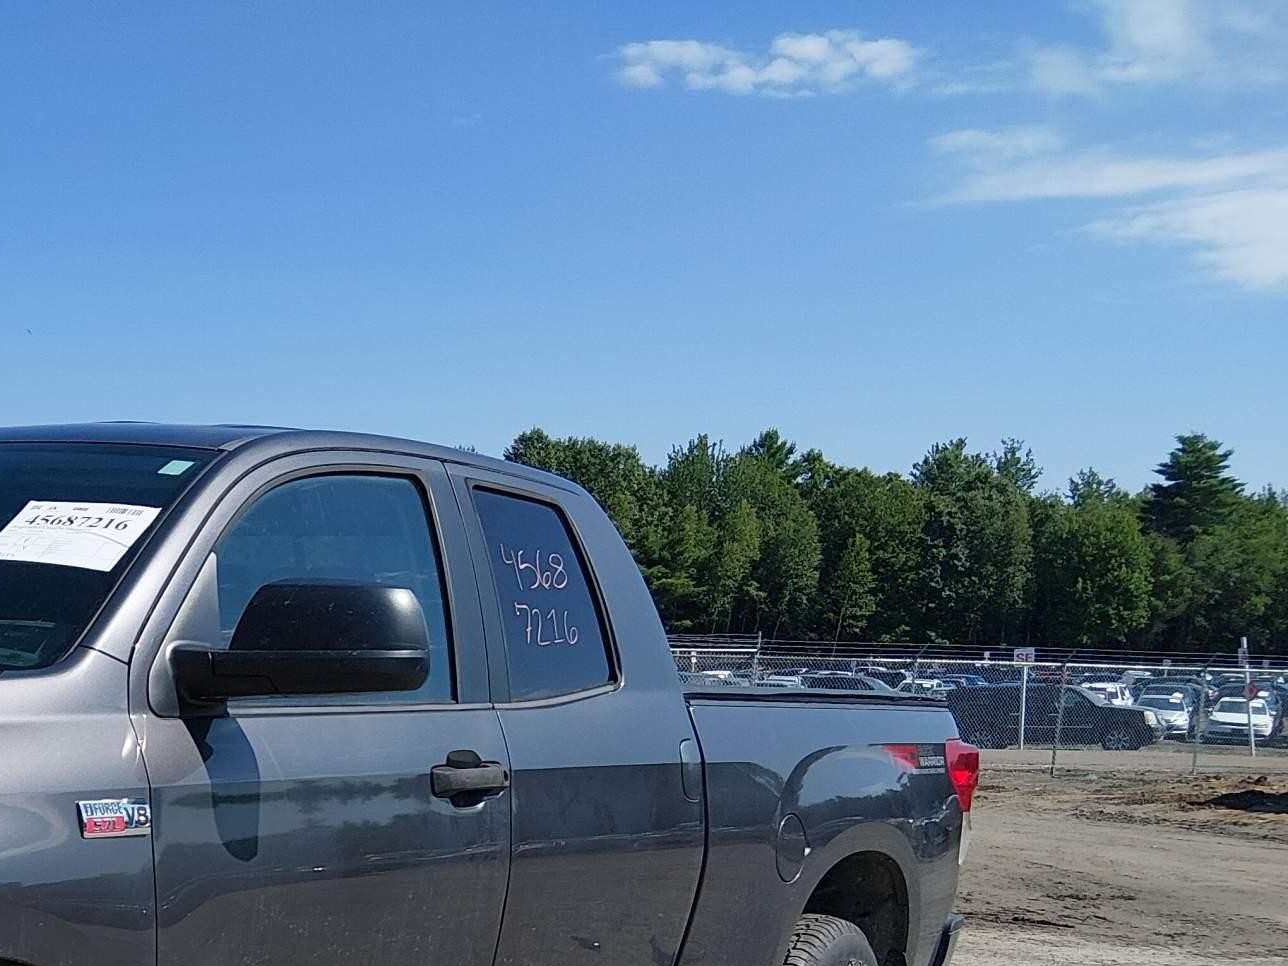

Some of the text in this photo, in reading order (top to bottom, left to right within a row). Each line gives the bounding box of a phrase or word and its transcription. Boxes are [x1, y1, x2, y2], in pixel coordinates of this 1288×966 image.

[24, 514, 133, 531] 45687216
[500, 543, 568, 591] 4568
[514, 602, 578, 645] 7216
[124, 806, 149, 827] V8
